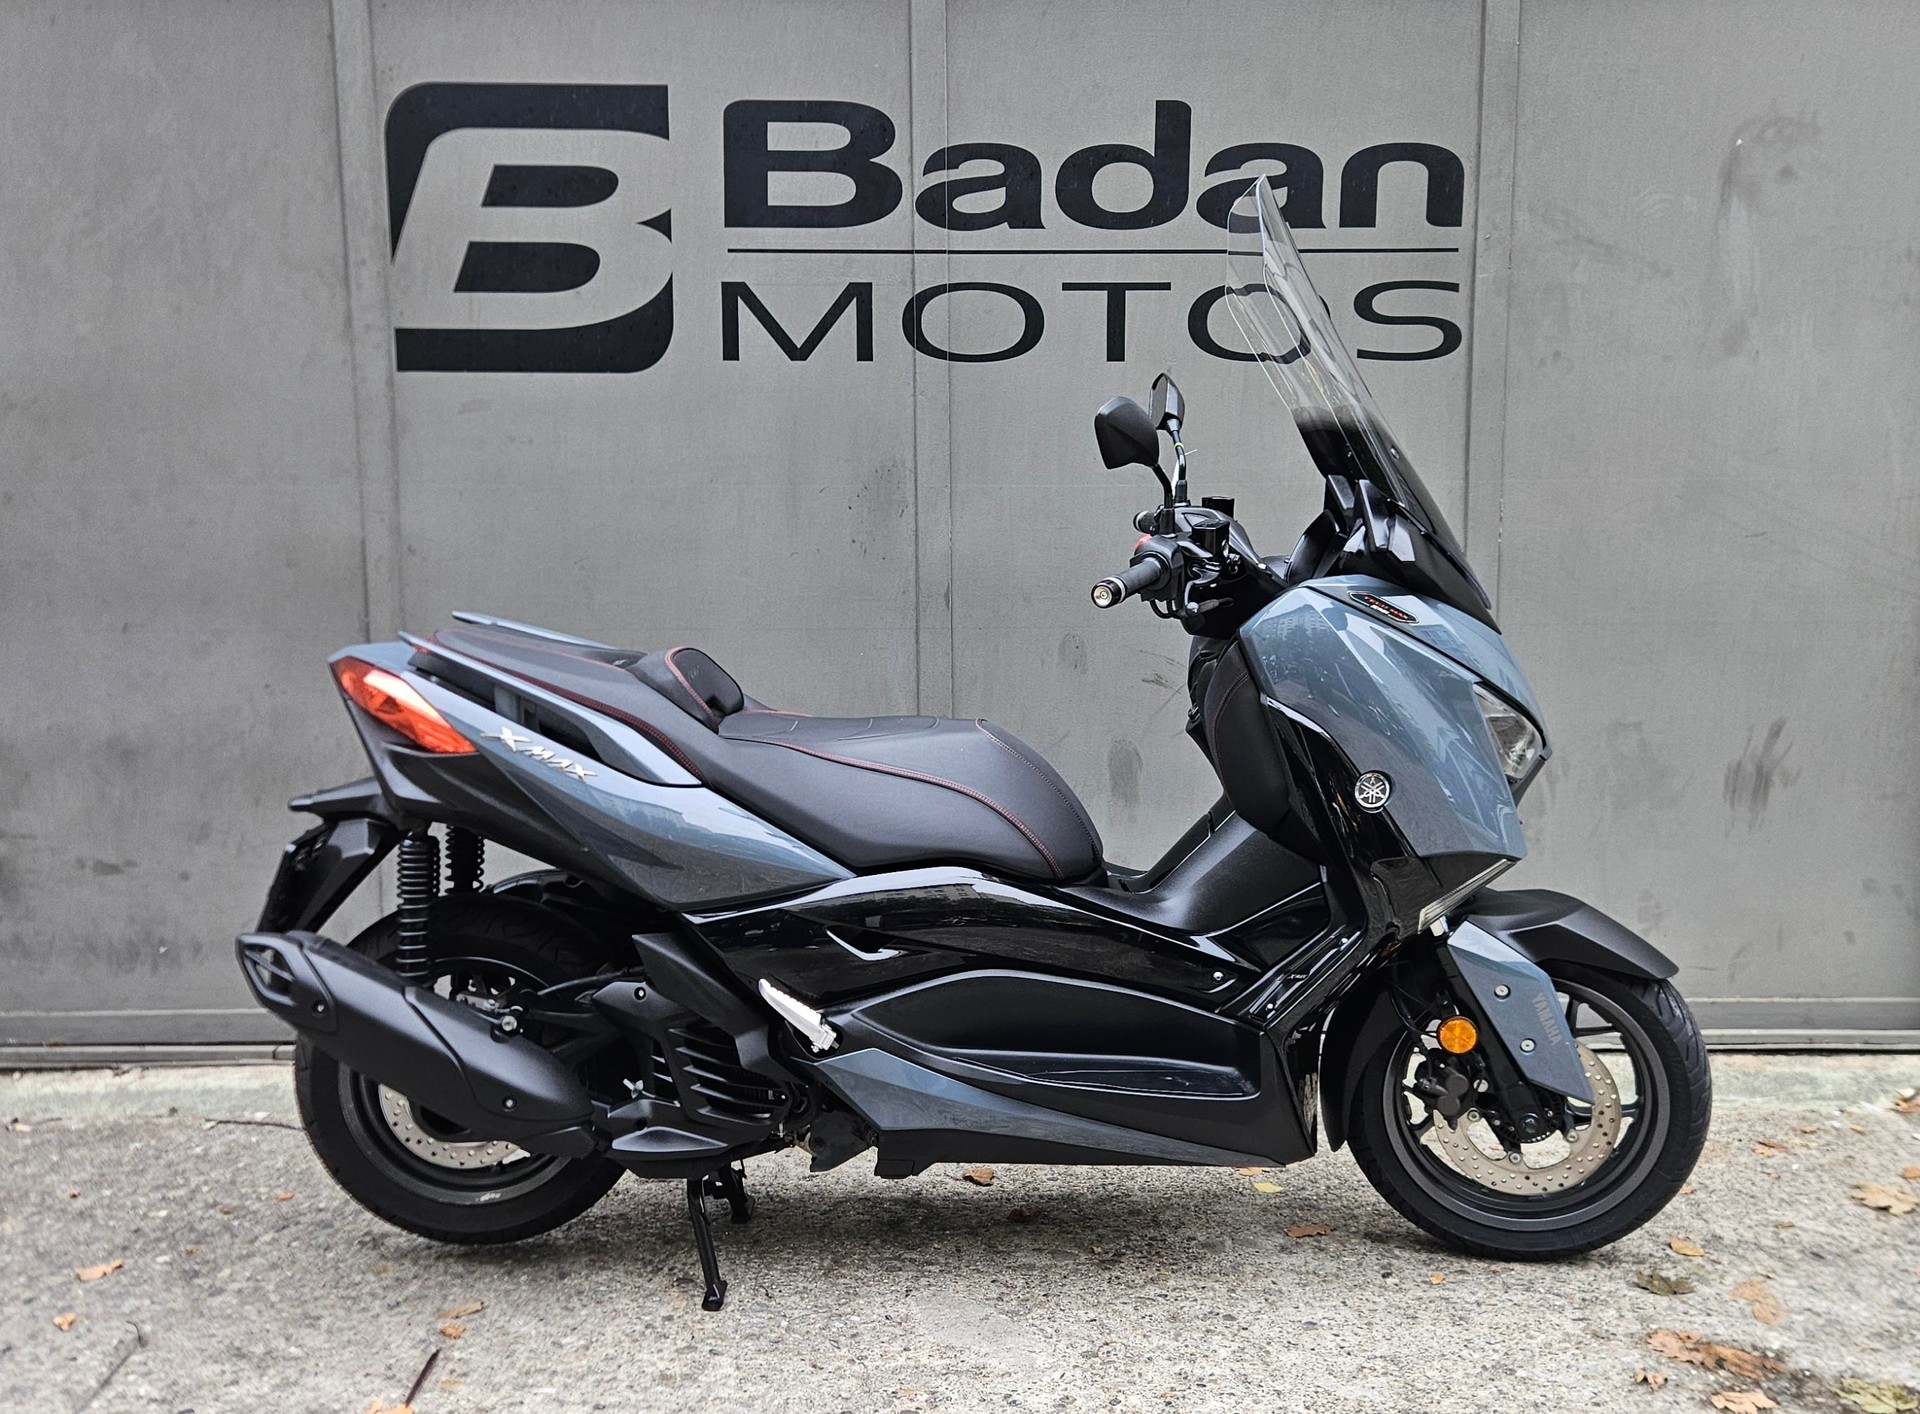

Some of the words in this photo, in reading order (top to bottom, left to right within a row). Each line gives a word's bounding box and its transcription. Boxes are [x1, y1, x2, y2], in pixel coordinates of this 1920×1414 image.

[723, 99, 1465, 232] Badan
[721, 280, 1463, 364] MOTOS
[1532, 992, 1563, 1046] YAMAHA
